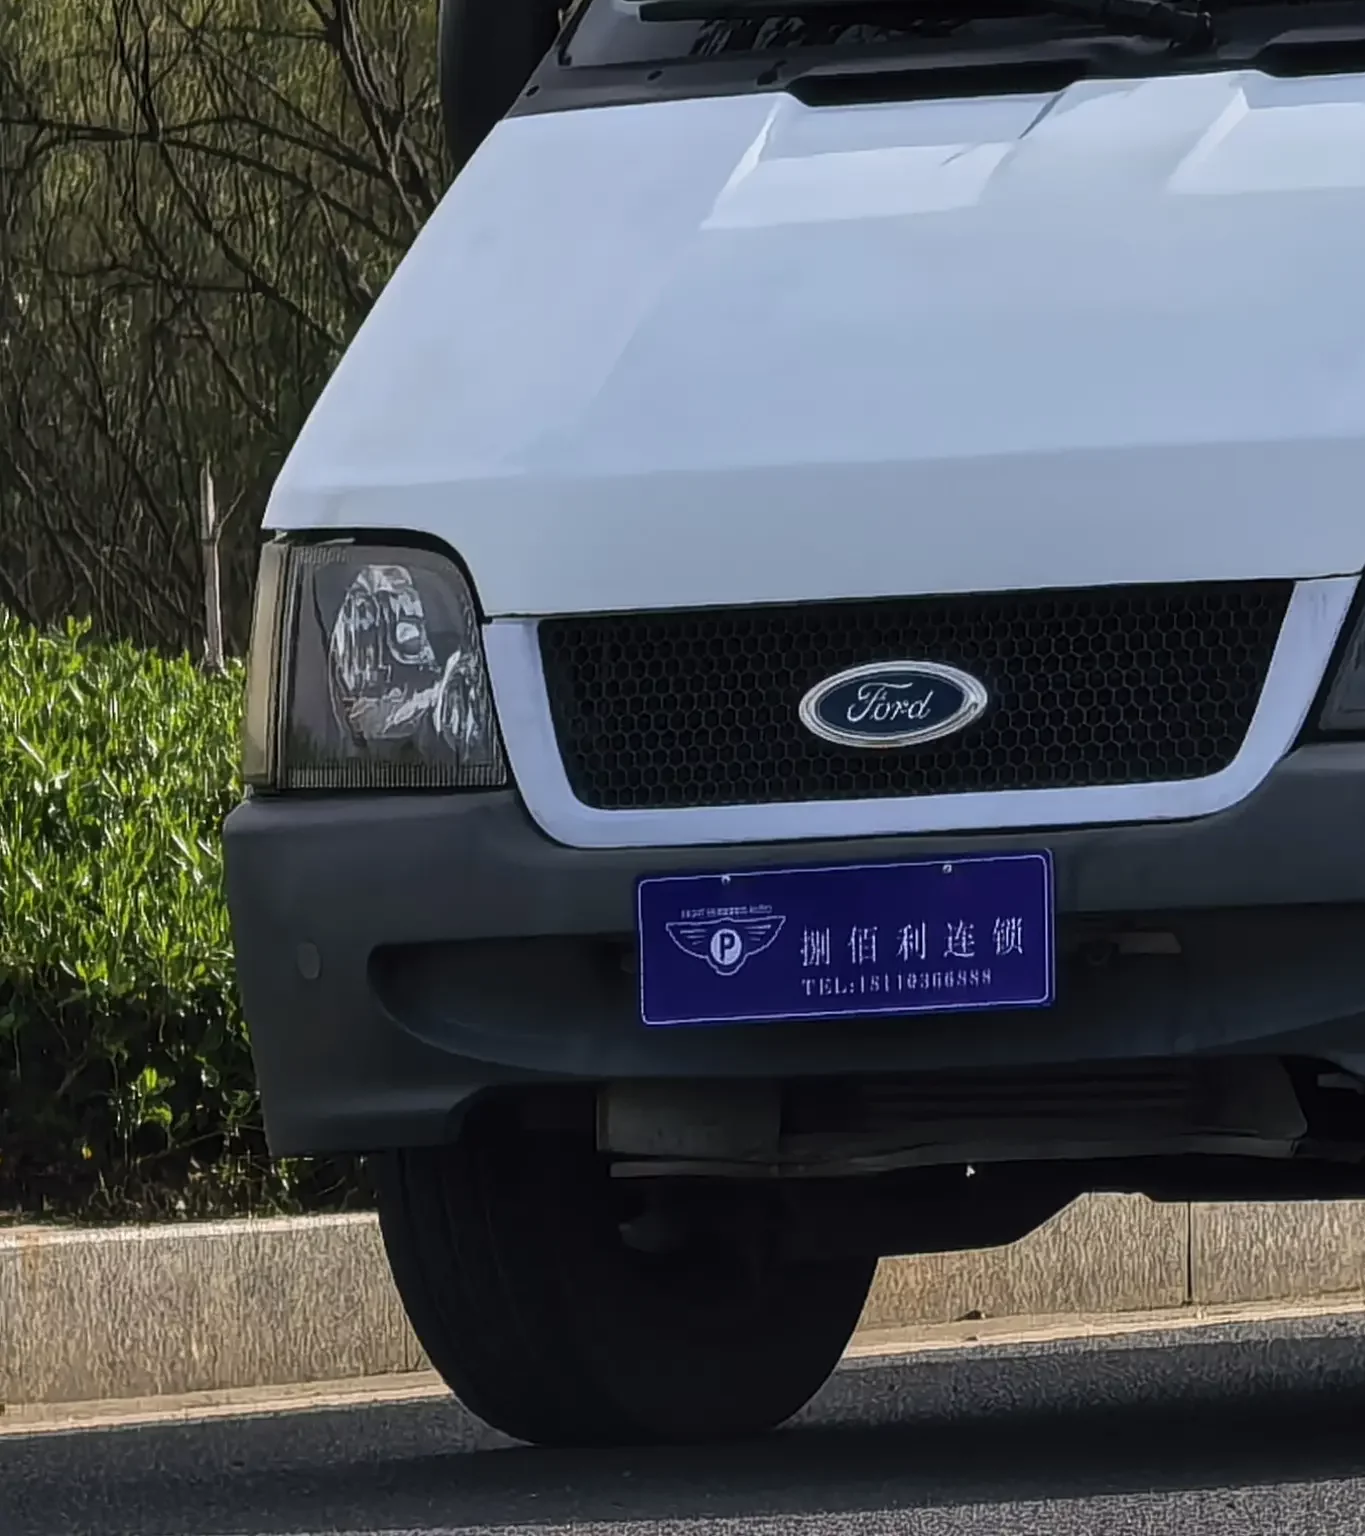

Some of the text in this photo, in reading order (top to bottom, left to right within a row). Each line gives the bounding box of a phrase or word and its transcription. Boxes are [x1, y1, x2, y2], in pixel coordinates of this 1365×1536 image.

[846, 681, 935, 723] Ford
[800, 916, 1024, 968] 捌佰利连锁
